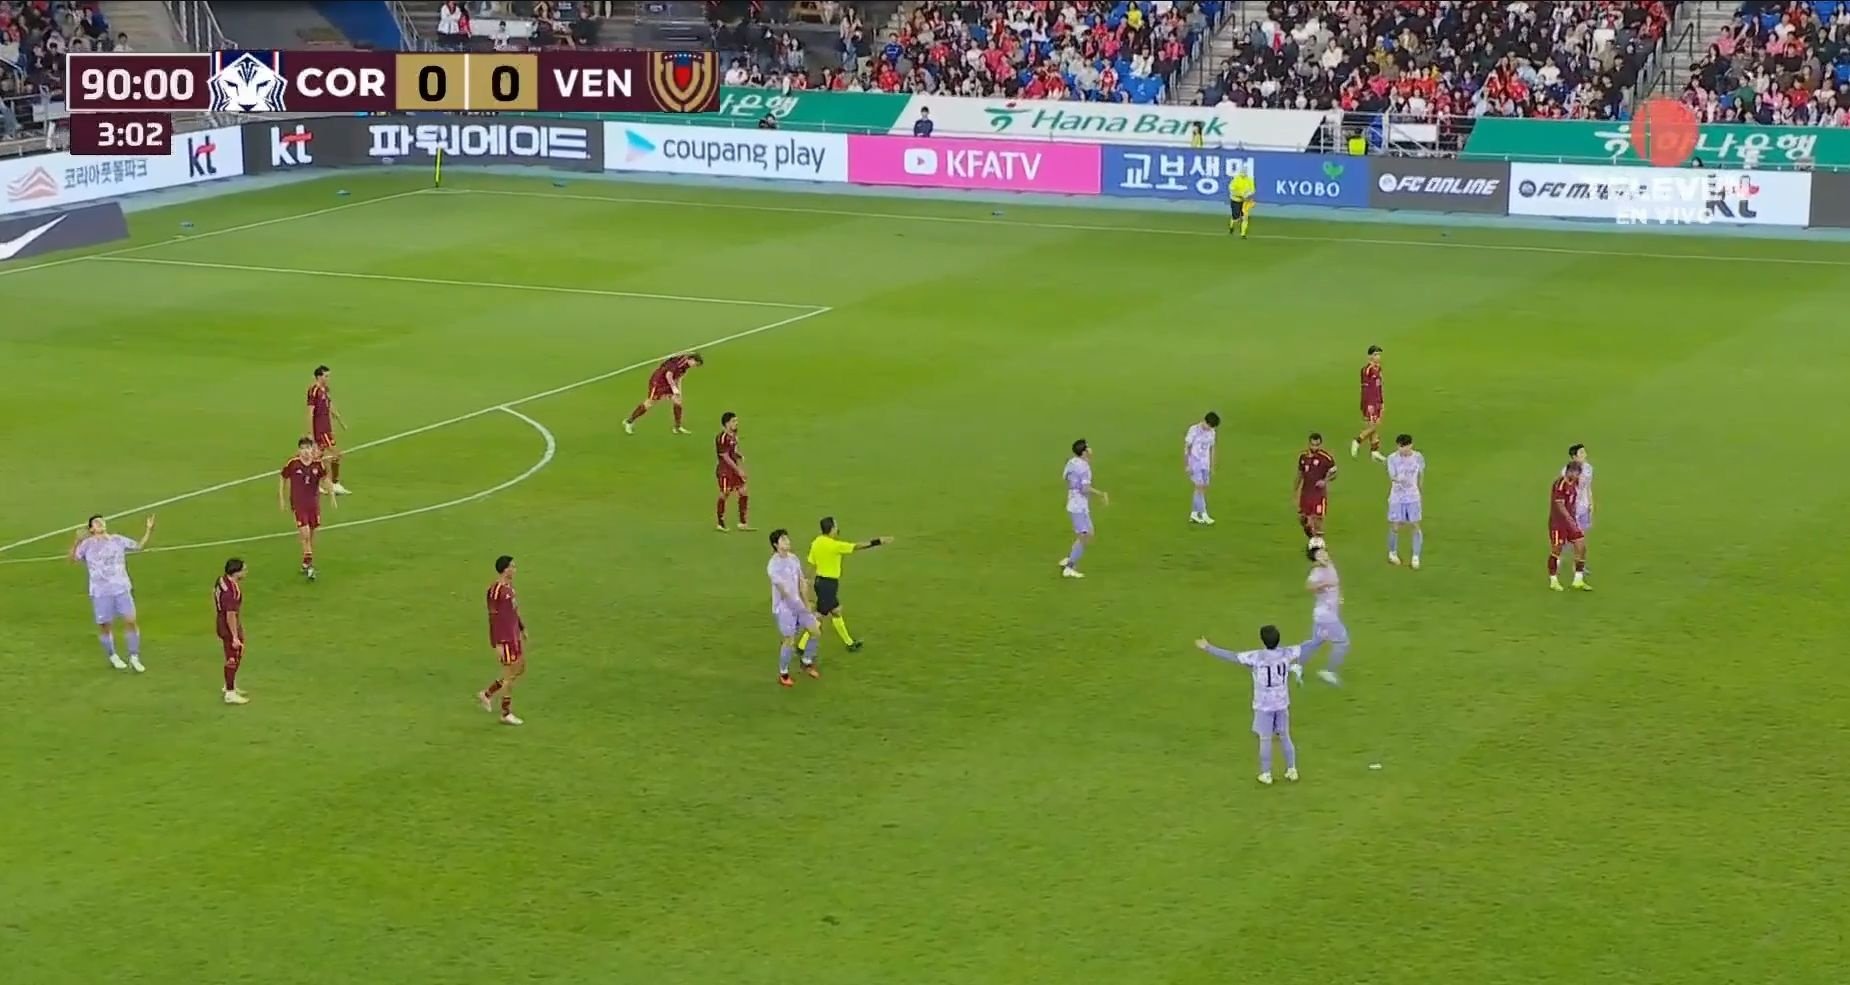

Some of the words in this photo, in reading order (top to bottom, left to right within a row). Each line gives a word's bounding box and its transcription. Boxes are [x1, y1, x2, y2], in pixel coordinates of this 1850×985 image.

[718, 92, 799, 118] 은행
[1031, 108, 1128, 132] Hana
[1132, 112, 1229, 136] Bank
[187, 135, 217, 178] kt
[270, 124, 313, 167] kt
[368, 124, 587, 160] 파워에이드
[663, 137, 767, 170] coupang
[776, 138, 826, 173] play
[946, 150, 1042, 181] KFATV
[1276, 178, 1341, 198] KYOBO
[1396, 175, 1427, 192] FC
[1424, 176, 1501, 196] ONLINE
[1537, 182, 1567, 198] FC
